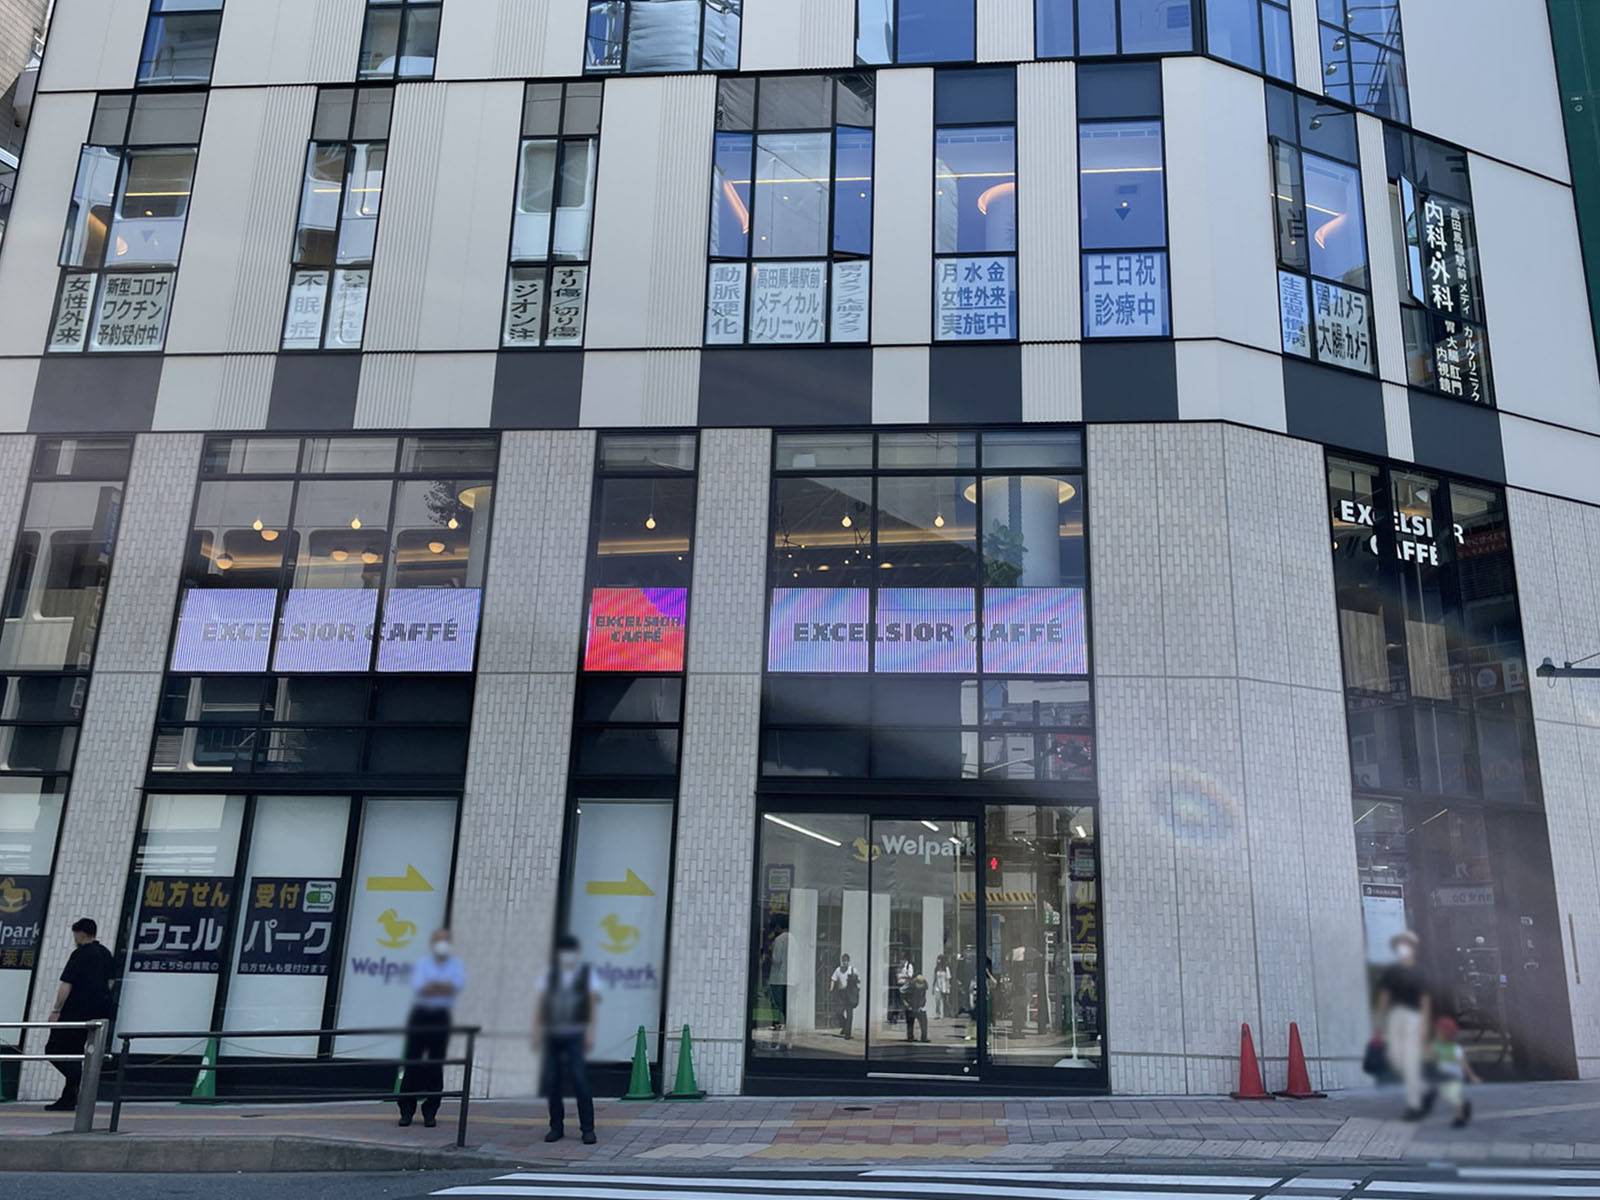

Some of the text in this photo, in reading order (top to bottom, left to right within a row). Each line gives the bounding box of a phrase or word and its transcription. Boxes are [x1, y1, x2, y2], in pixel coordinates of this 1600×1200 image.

[1424, 200, 1454, 312] 内科・外科
[757, 268, 821, 289] 高田馬場駅前
[942, 262, 1005, 283] 月水金
[1094, 255, 1156, 286] 土日祝
[106, 277, 168, 296] 新型コロナ
[942, 286, 1006, 307] 女性外来
[56, 277, 91, 343] 女性外来
[103, 300, 162, 320] ワクチン
[289, 274, 324, 338] 不眠症
[711, 267, 741, 335] 動脈硬化
[757, 291, 820, 314] メディカル
[1095, 292, 1156, 325] 診療中
[1316, 283, 1364, 325] 胃カメラ
[98, 324, 159, 346] 予約受付中
[756, 316, 818, 340] クリニック
[941, 312, 1006, 336] 実施中
[1318, 319, 1368, 365] 大腸カメラ
[1341, 500, 1464, 544] EXELSIR
[596, 616, 681, 627] EXCELSIOR
[794, 622, 953, 642] EXCELSIOR
[611, 628, 663, 642] CAFFÉ
[144, 881, 230, 907] 処方せん
[254, 883, 300, 908] 受付
[244, 919, 332, 953] パーク
